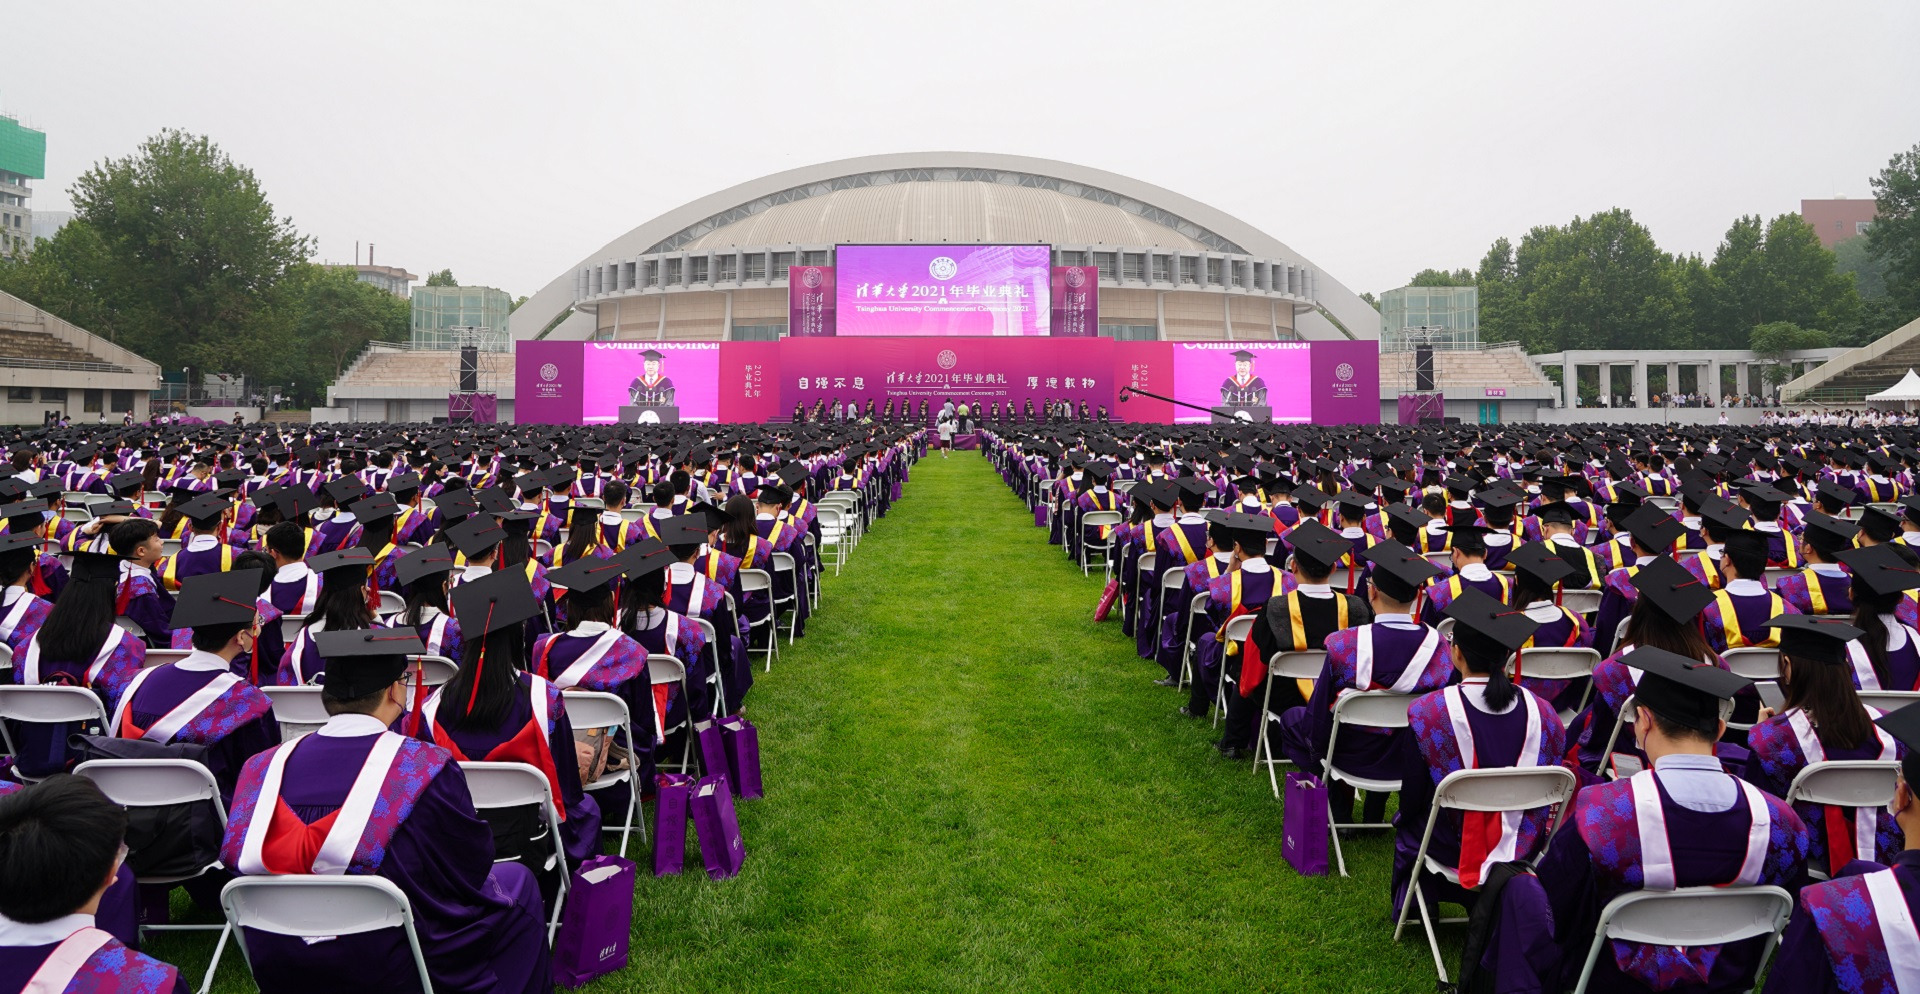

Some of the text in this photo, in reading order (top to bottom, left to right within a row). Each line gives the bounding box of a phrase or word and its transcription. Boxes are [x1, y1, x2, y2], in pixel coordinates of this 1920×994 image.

[856, 305, 887, 313] Tsinghua
[888, 305, 923, 313] University
[798, 376, 865, 390] 自强不息
